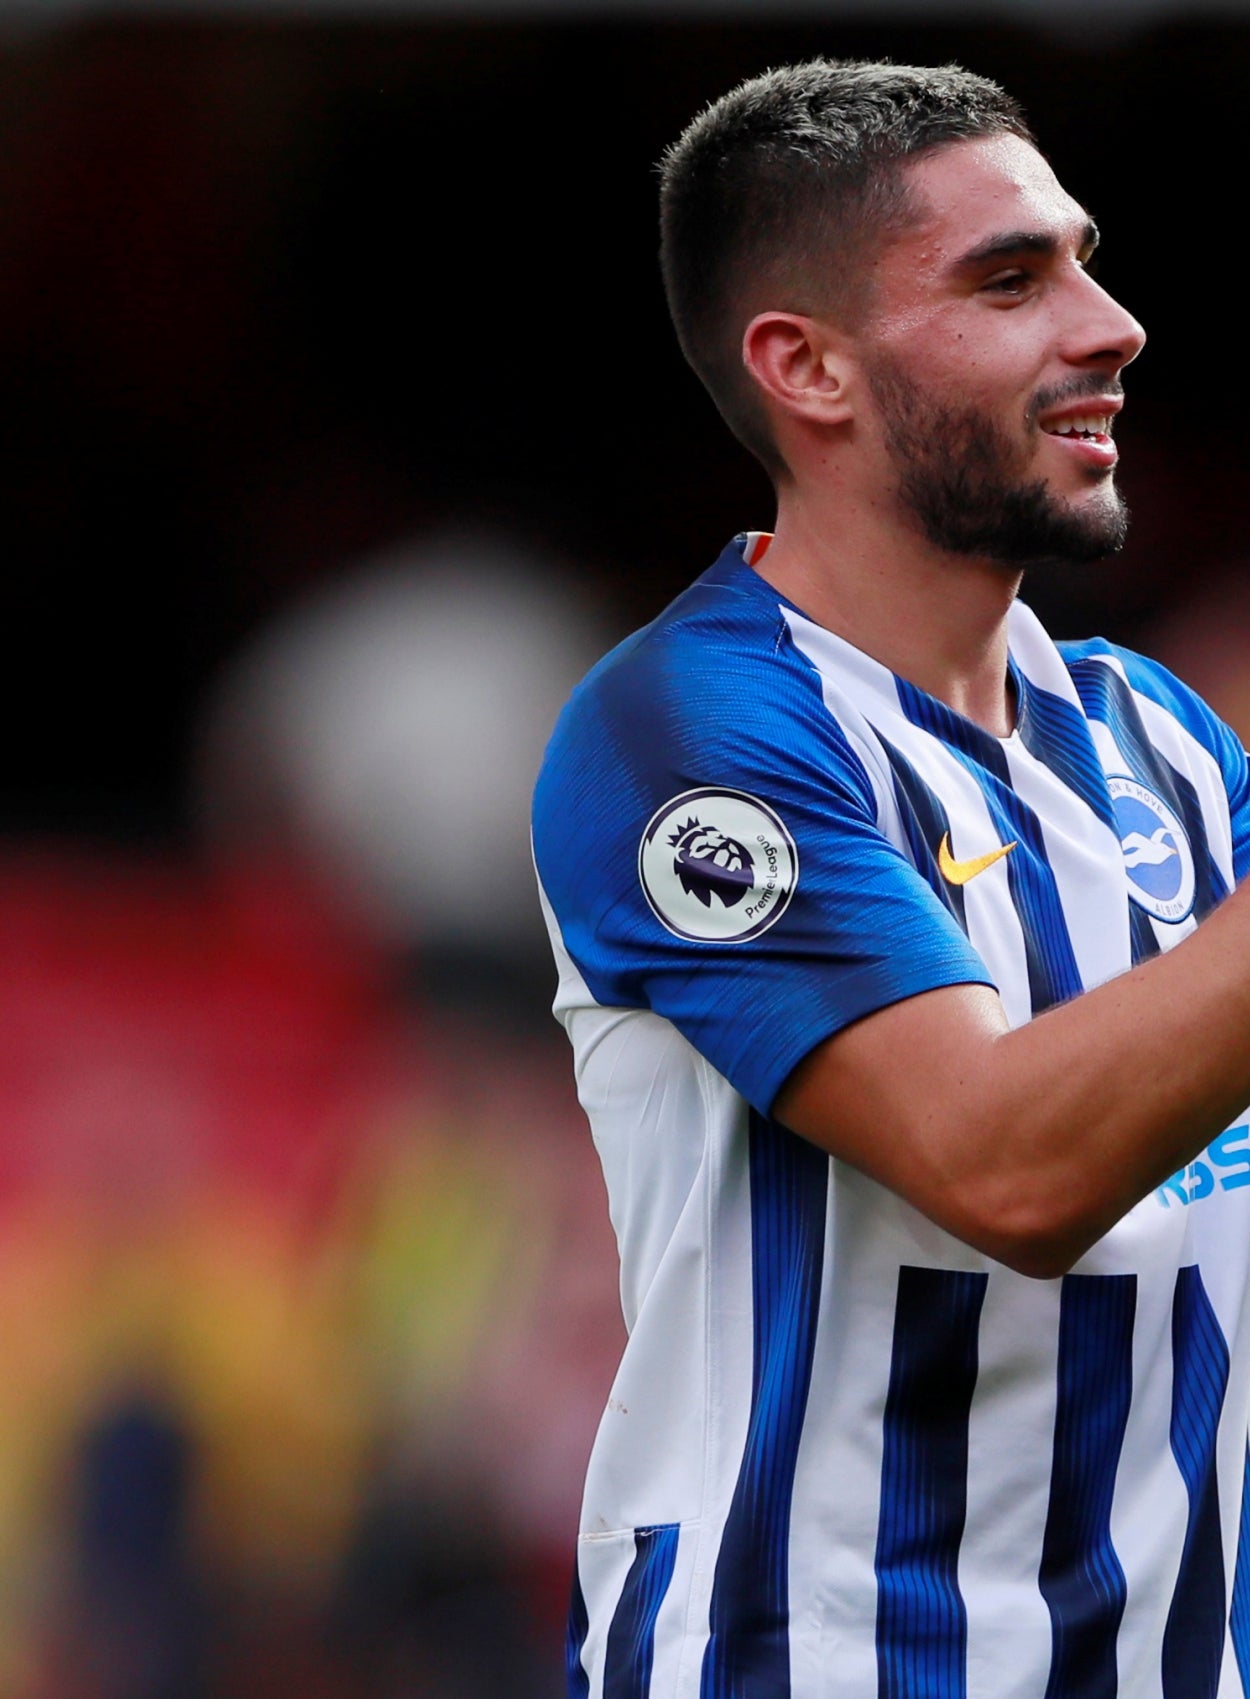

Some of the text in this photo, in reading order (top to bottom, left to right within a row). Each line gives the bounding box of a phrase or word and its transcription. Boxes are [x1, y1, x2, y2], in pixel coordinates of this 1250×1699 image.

[1136, 787, 1163, 813] HOVE
[756, 834, 778, 879] League
[1155, 903, 1184, 917] ALBION
